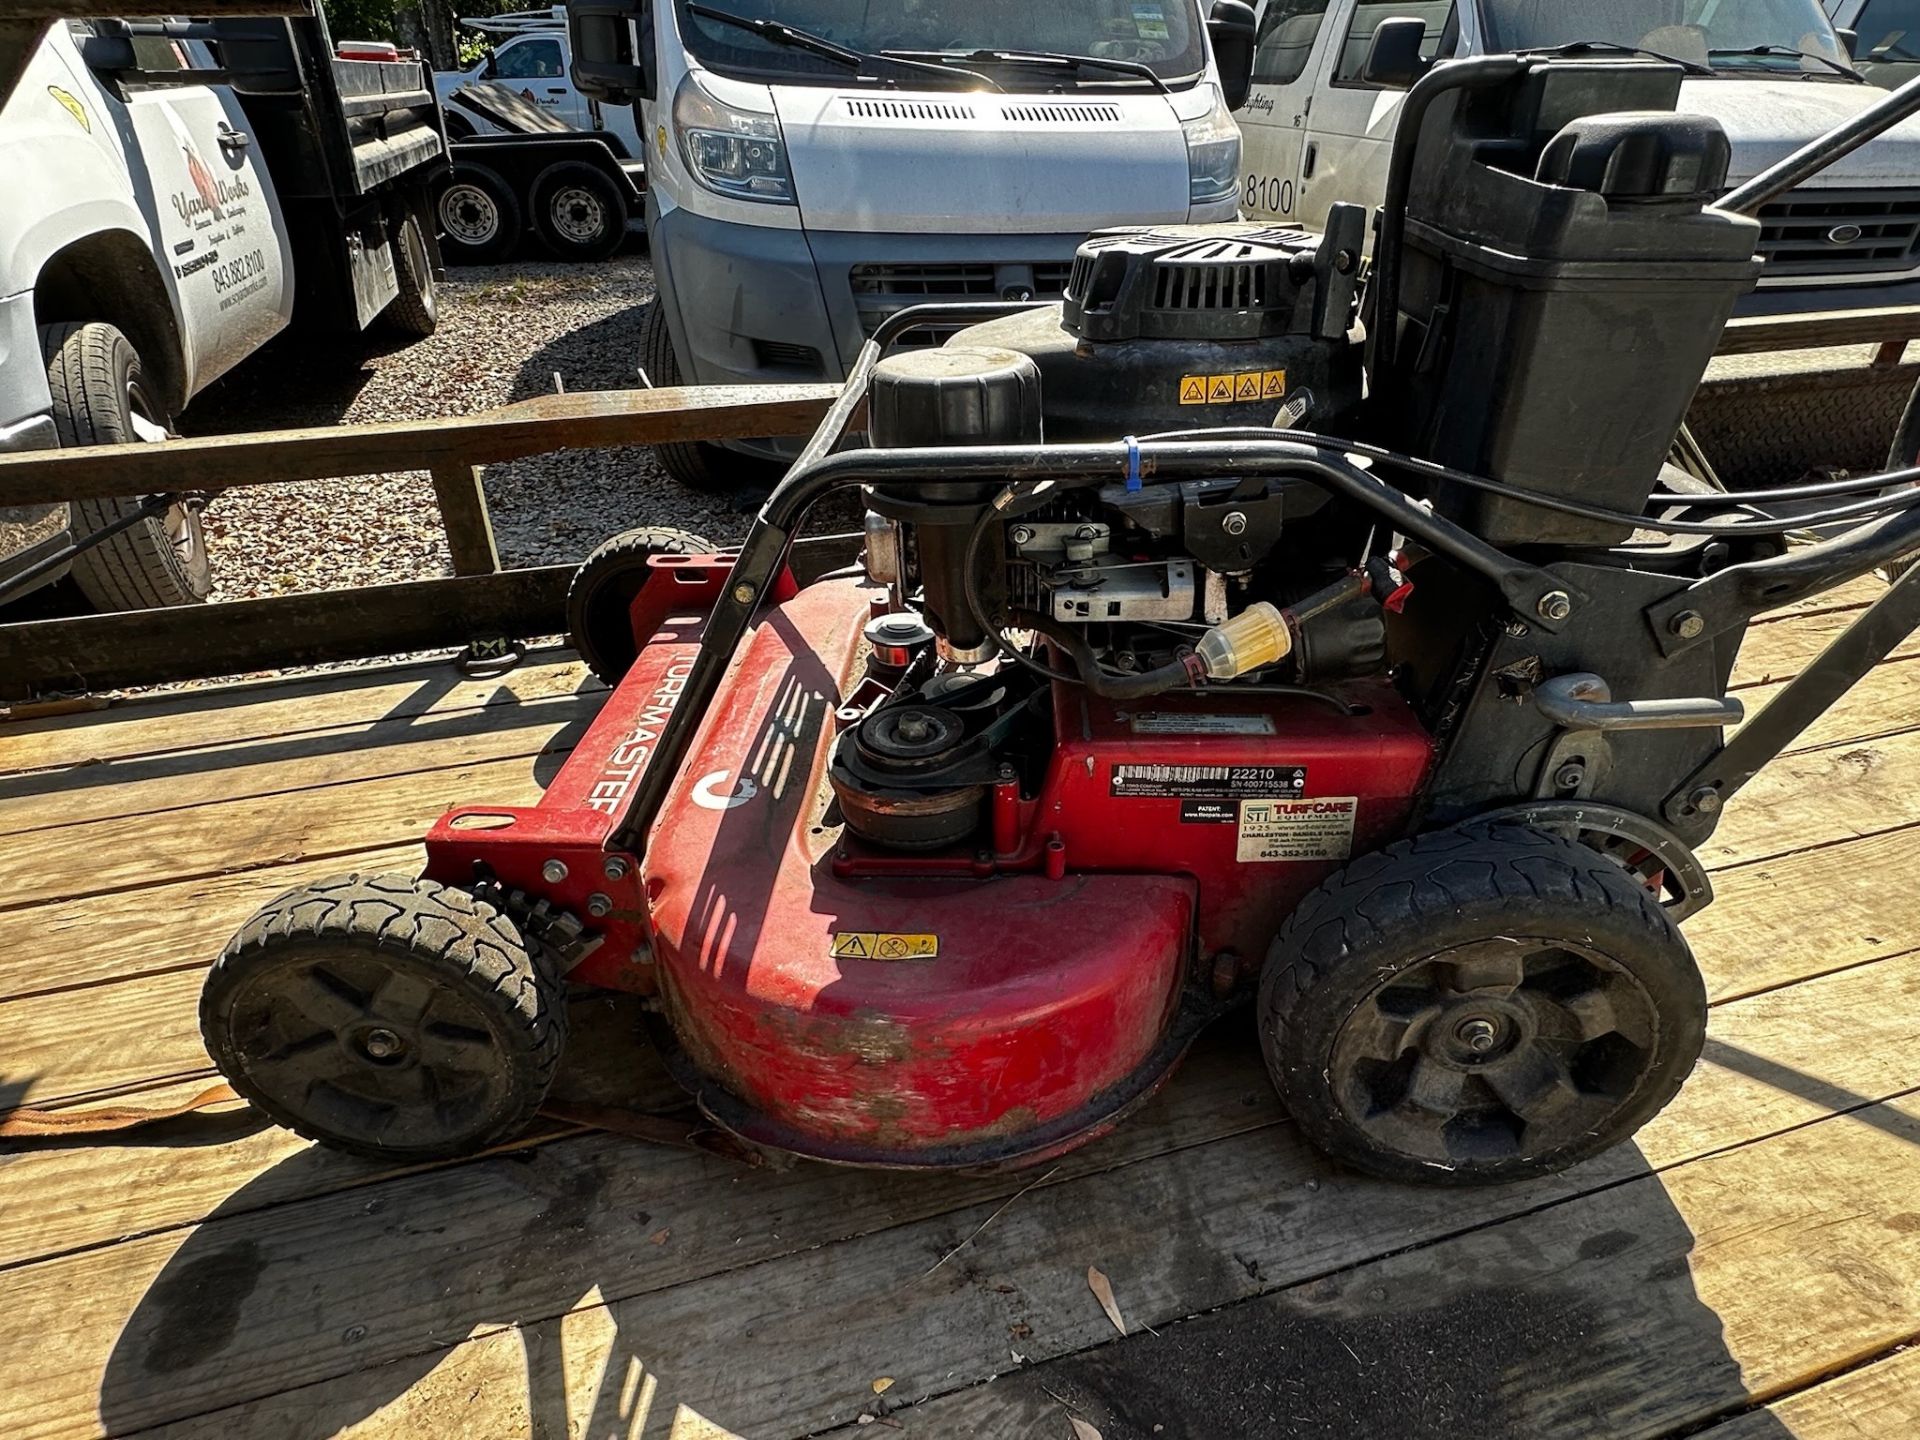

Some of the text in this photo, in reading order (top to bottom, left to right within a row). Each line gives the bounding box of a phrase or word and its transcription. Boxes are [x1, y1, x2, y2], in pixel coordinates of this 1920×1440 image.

[1243, 93, 1274, 116] ighting
[172, 174, 249, 228] Yard Works
[211, 248, 265, 294] 843.882.8100
[1231, 768, 1275, 780] 22210
[1243, 780, 1289, 789] 400715538
[1246, 812, 1269, 822] STI
[1276, 813, 1347, 821] EQUIPMENT
[1575, 811, 1584, 820] 3
[1243, 824, 1271, 832] 1925
